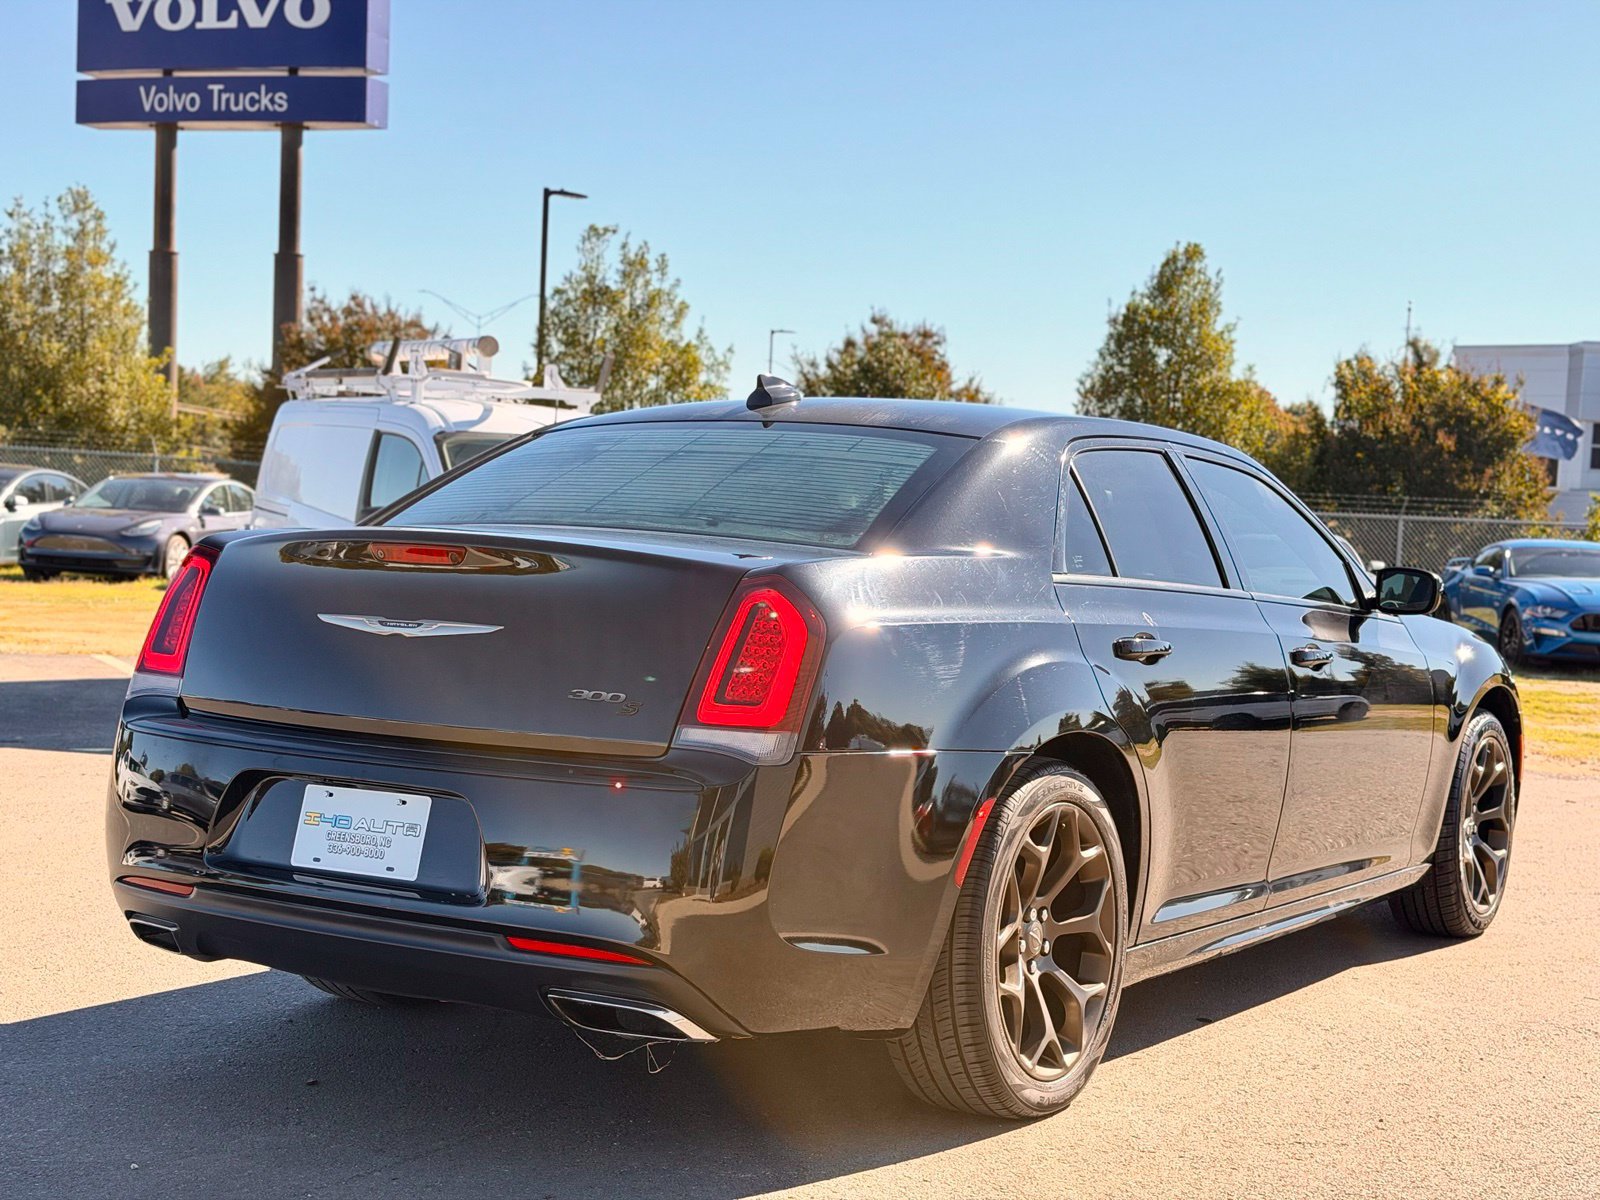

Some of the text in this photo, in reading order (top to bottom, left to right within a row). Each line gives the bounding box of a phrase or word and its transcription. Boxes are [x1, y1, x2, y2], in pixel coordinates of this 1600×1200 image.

[100, 0, 331, 32] VOLVO
[139, 83, 288, 113] Volvo Trucks
[567, 689, 627, 703] 300
[326, 830, 392, 848] GREENSBORO, NC
[327, 843, 385, 860] 336-900-8000
